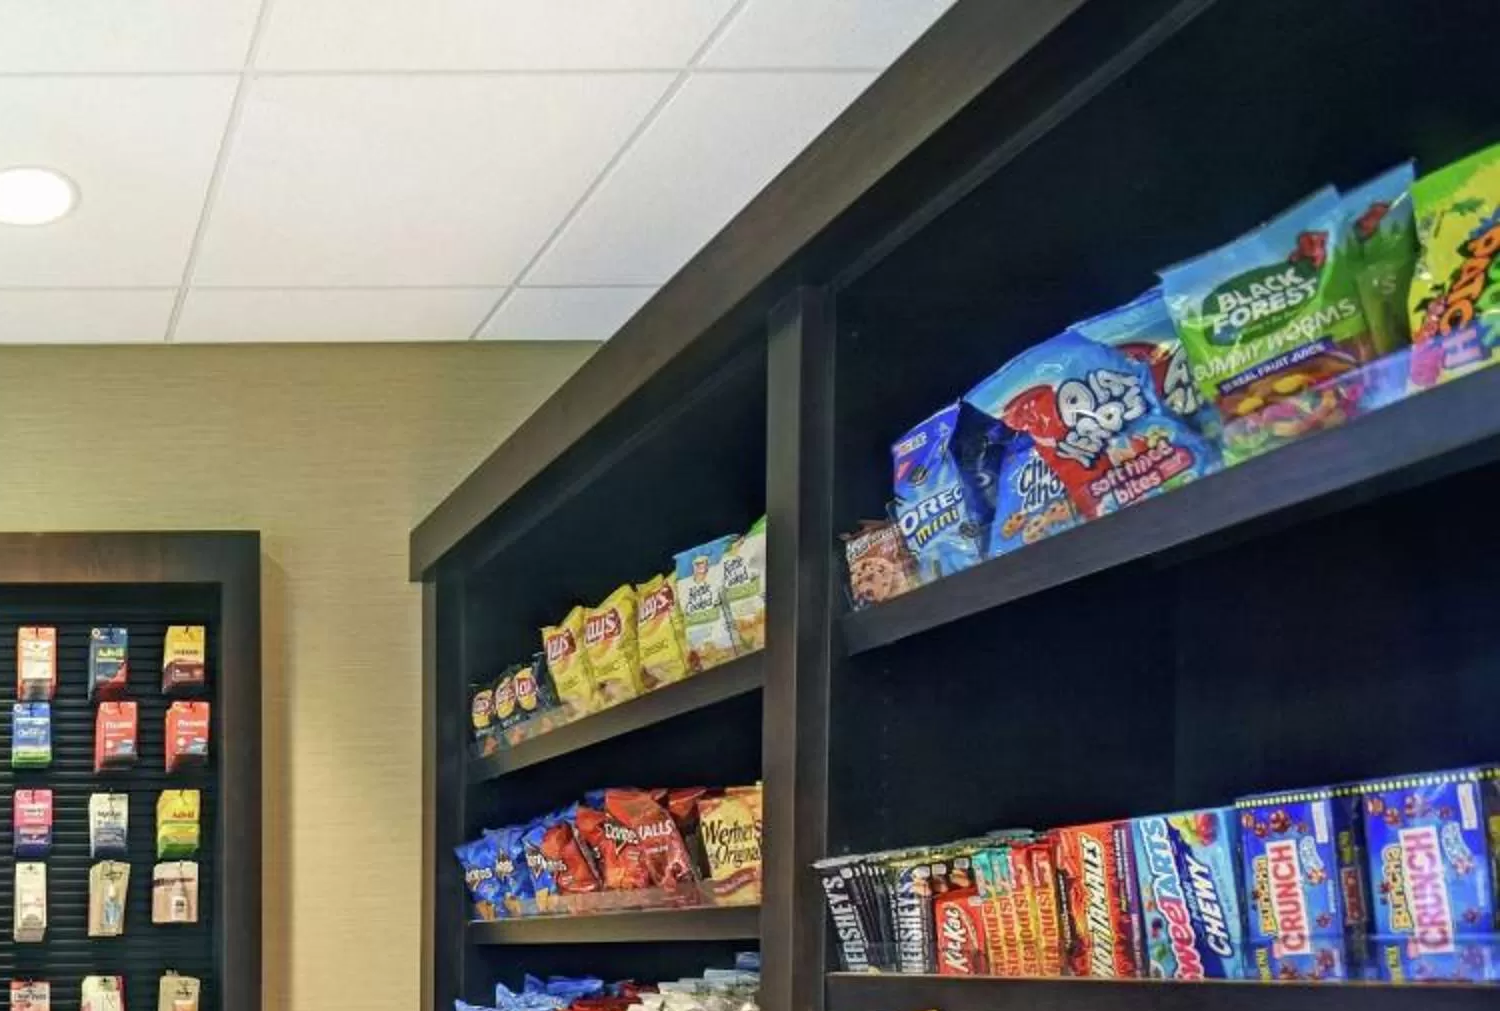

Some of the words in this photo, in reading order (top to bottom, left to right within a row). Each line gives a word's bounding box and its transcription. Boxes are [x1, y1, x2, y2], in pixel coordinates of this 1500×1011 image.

[1213, 277, 1318, 336] FOREST
[1217, 267, 1304, 313] BLACK
[1194, 339, 1262, 382] GUMMY
[1266, 297, 1356, 351] WORMS
[916, 508, 959, 545] mini
[1114, 471, 1161, 505] bites
[822, 876, 870, 973] HERSHEY'S
[1082, 837, 1114, 939] TAMALES
[1185, 854, 1233, 957] CHEWY
[1271, 844, 1306, 951] CRUNCH
[1403, 831, 1449, 947] CRUNCH
